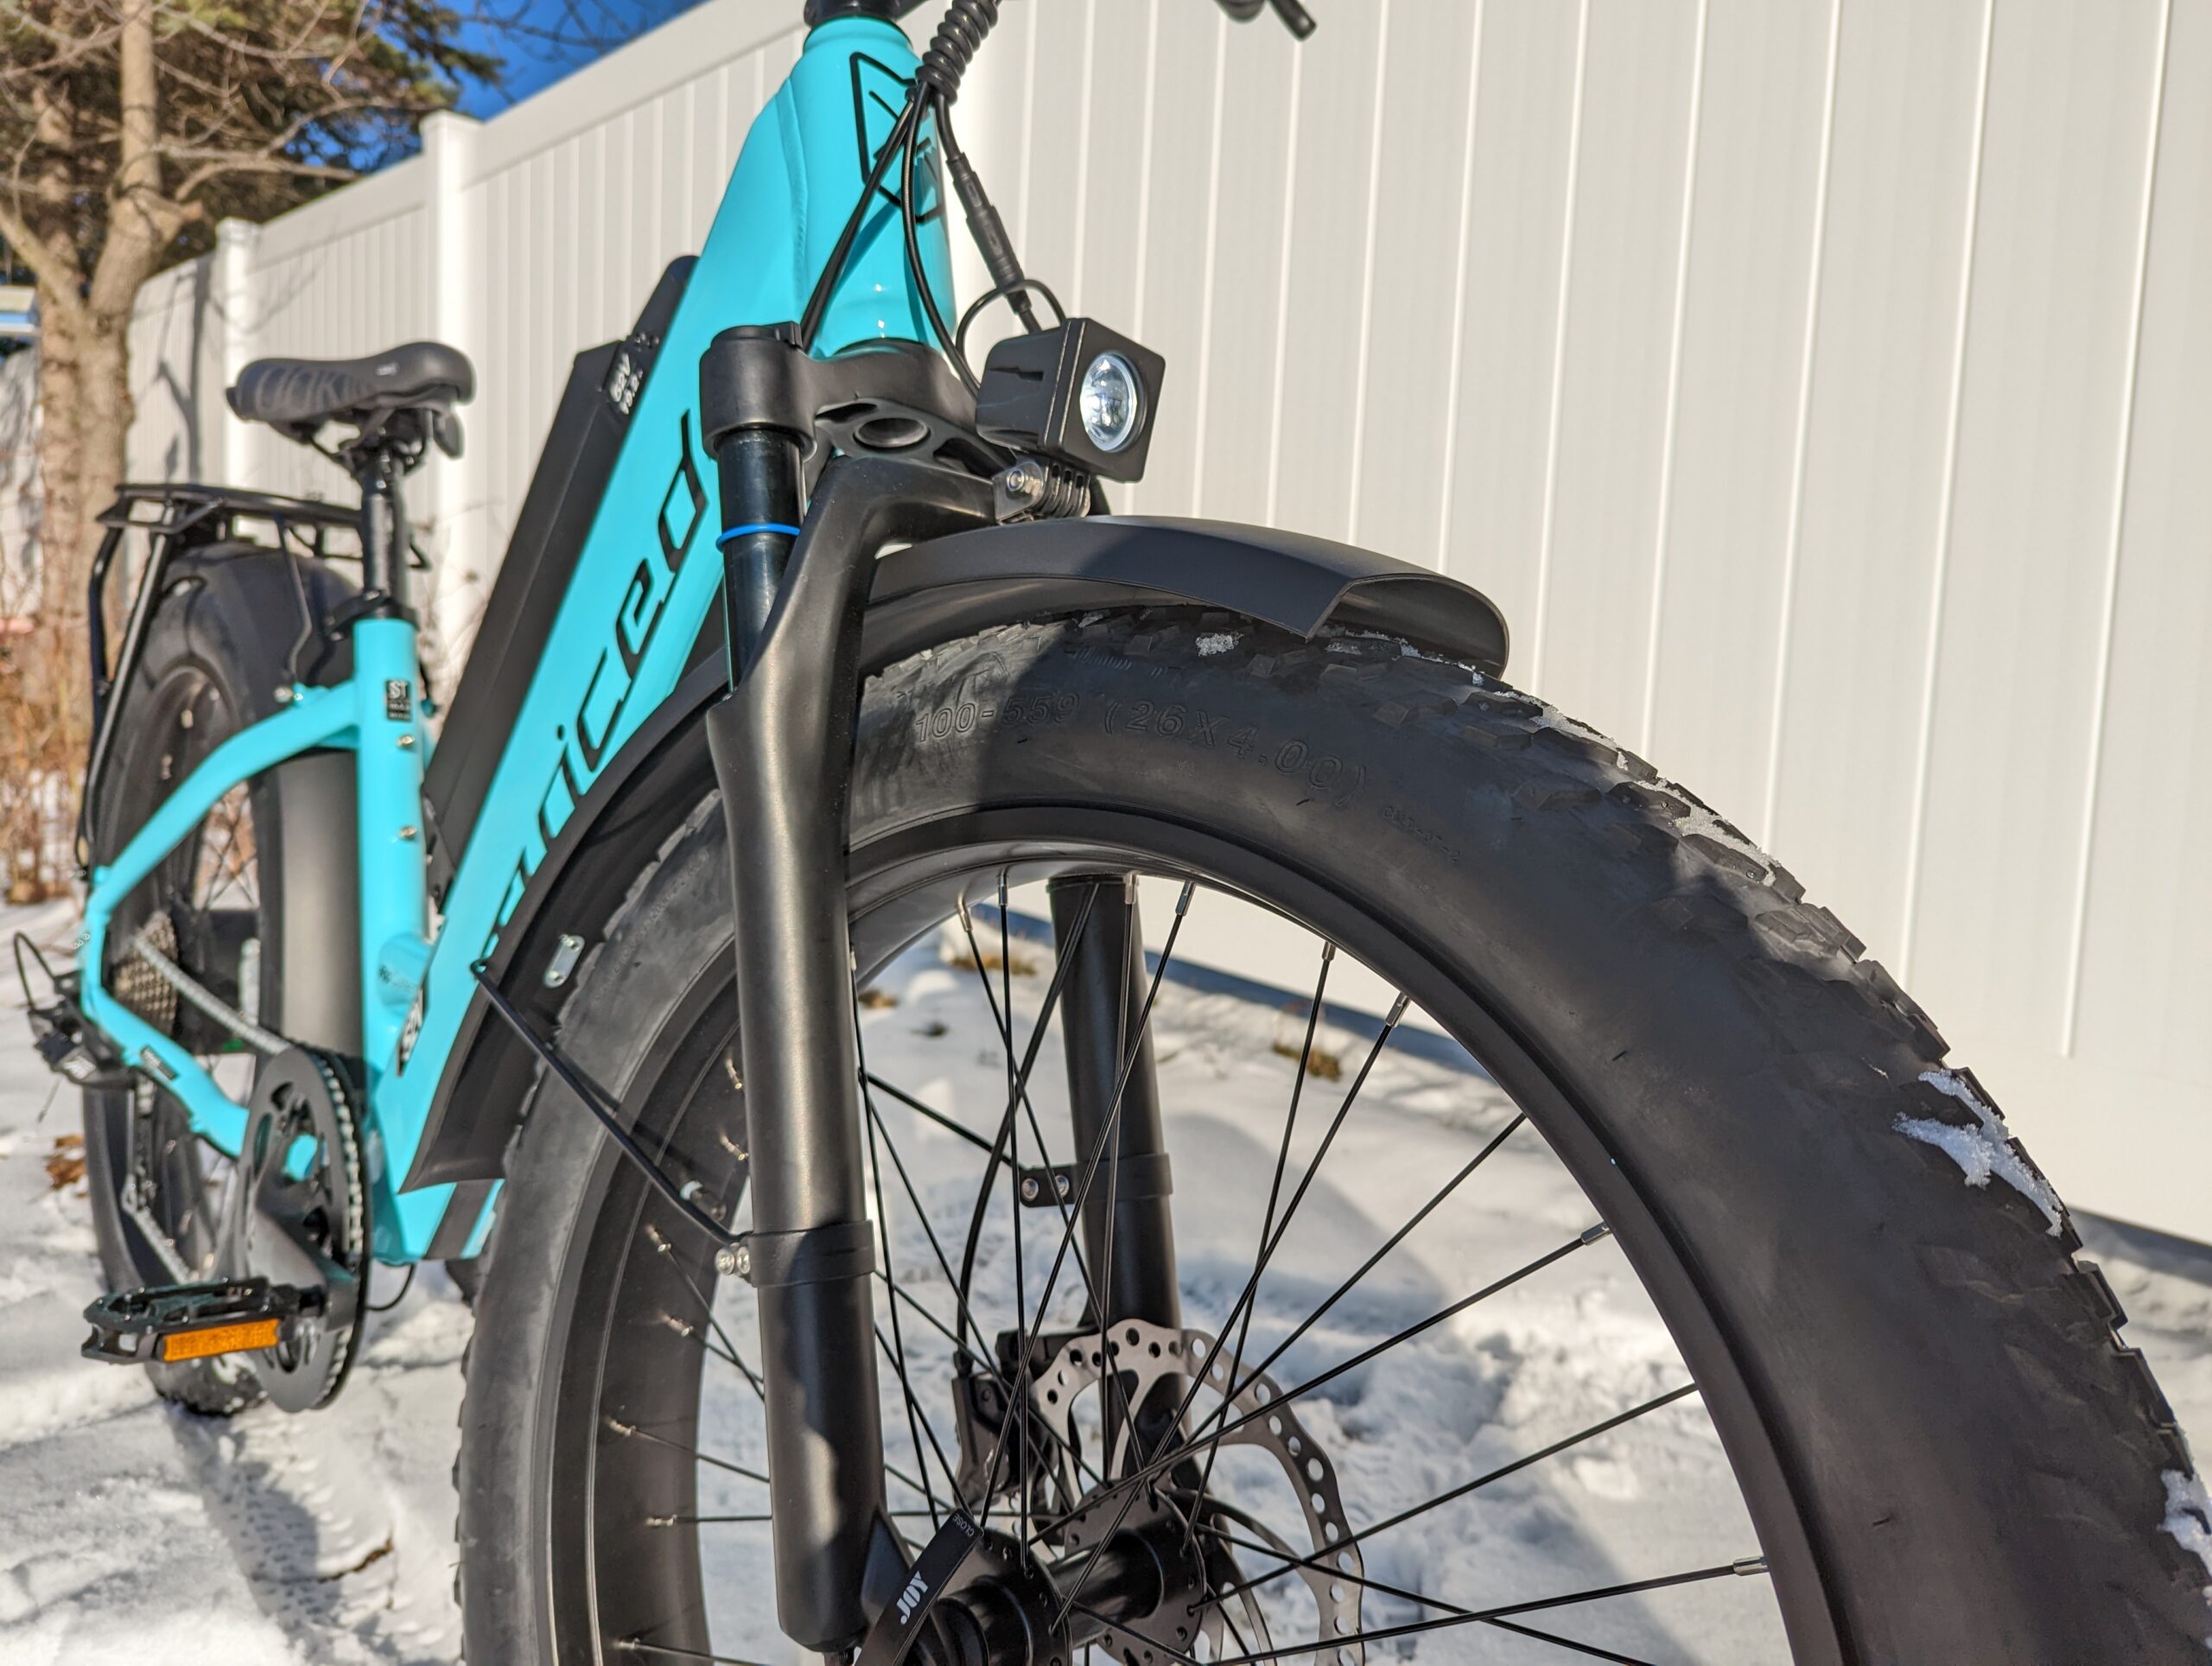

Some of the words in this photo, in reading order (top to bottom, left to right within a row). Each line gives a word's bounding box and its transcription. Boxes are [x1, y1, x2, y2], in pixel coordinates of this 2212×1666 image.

[915, 693, 1081, 743] 100-559
[952, 1513, 975, 1537] CLOSE
[896, 1570, 929, 1625] JOY
